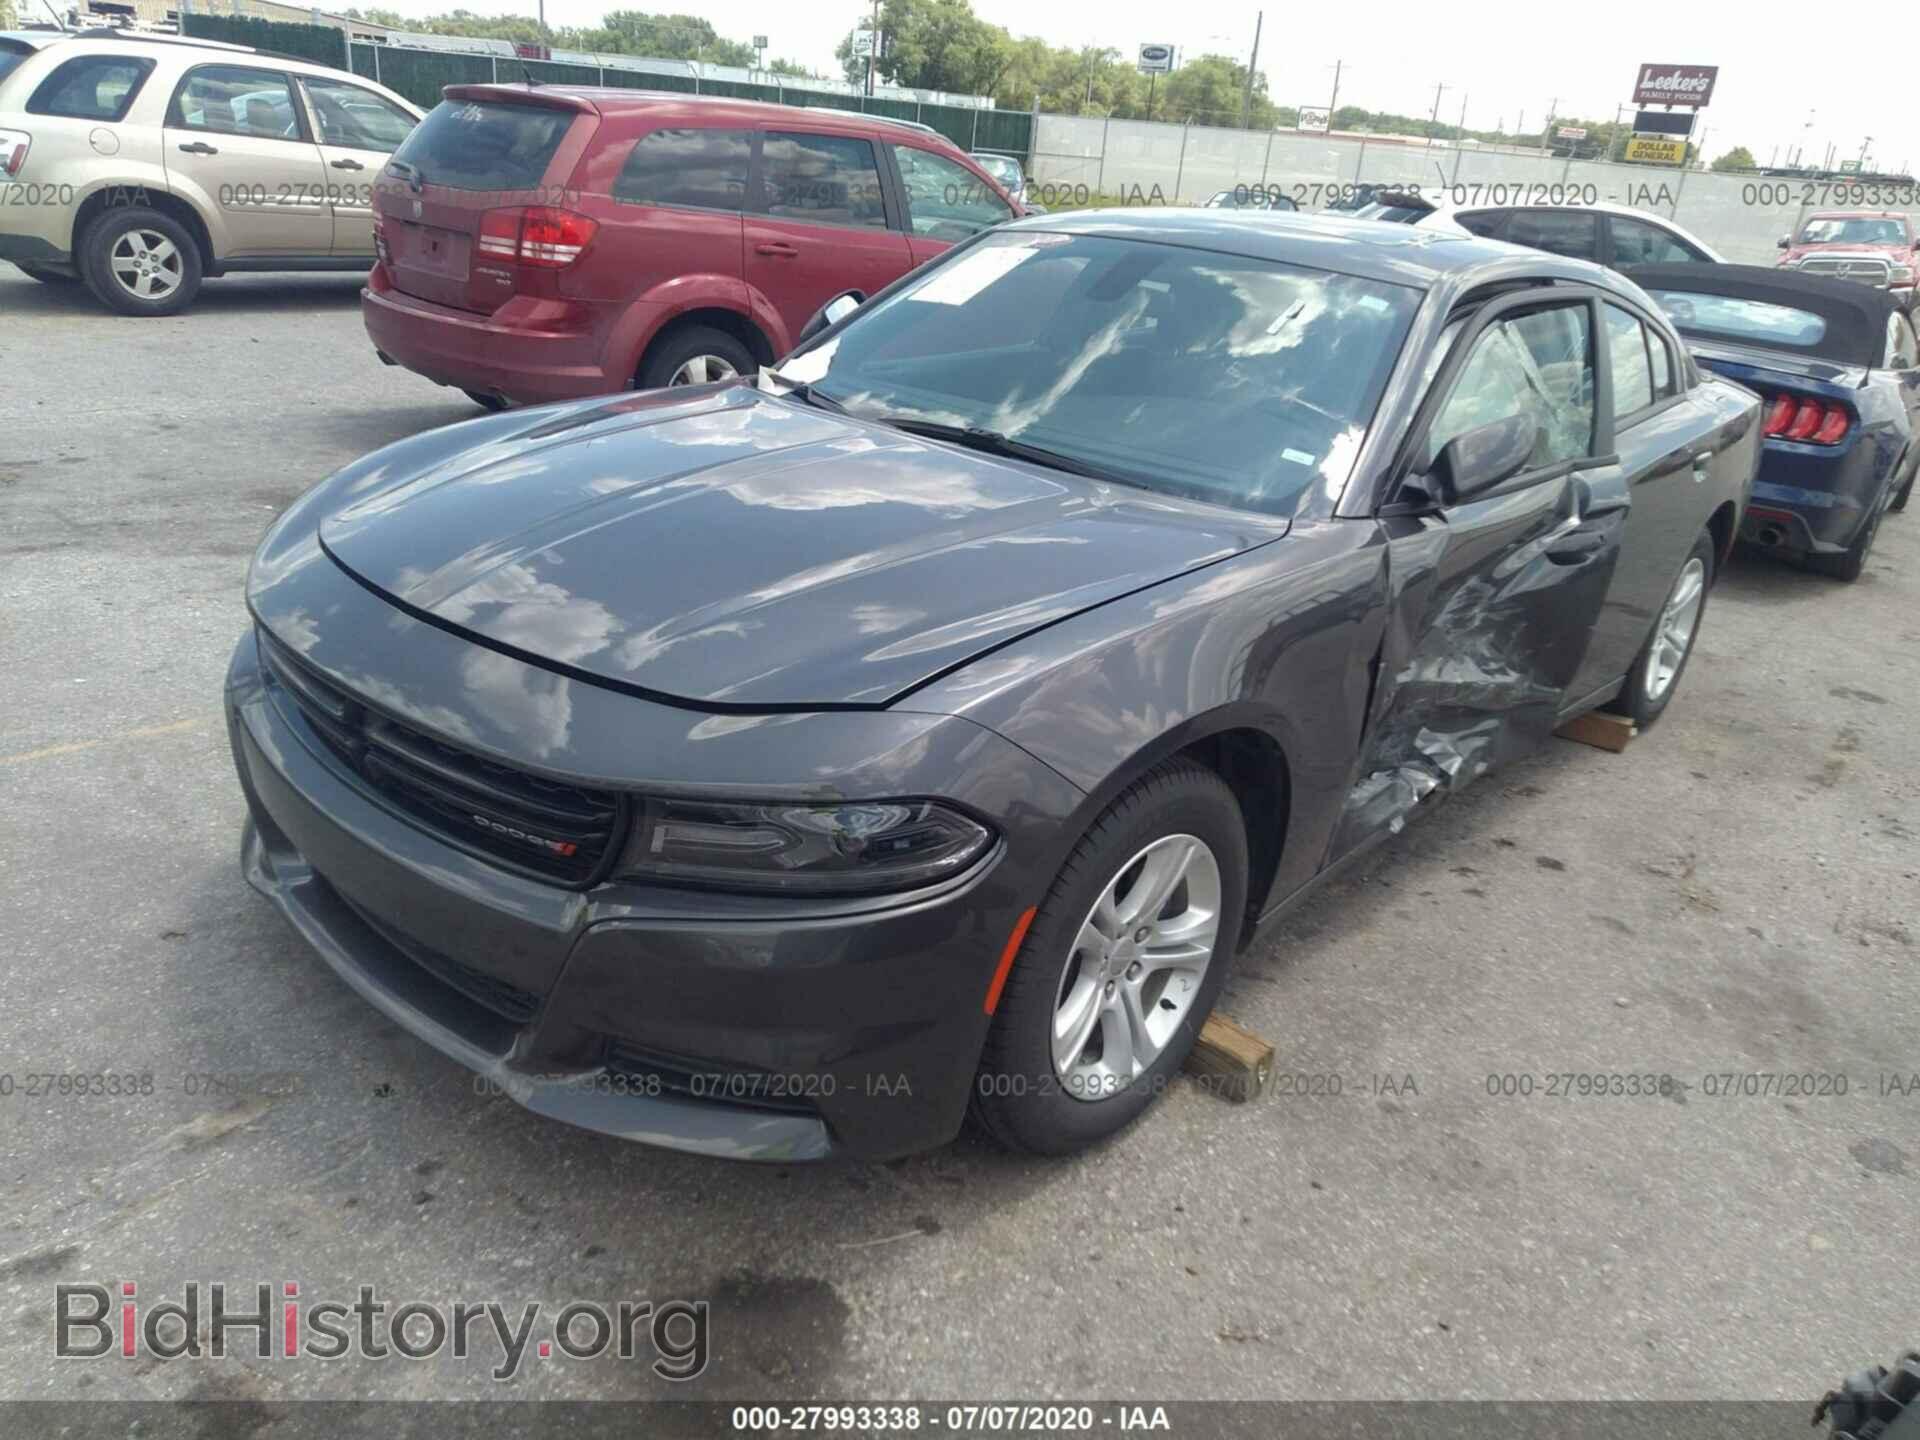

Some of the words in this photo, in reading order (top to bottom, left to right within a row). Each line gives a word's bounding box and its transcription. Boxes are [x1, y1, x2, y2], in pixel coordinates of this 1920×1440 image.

[1640, 69, 1709, 92] Leeker's
[1637, 142, 1676, 151] DOLLAR
[1632, 151, 1676, 160] GENERAL
